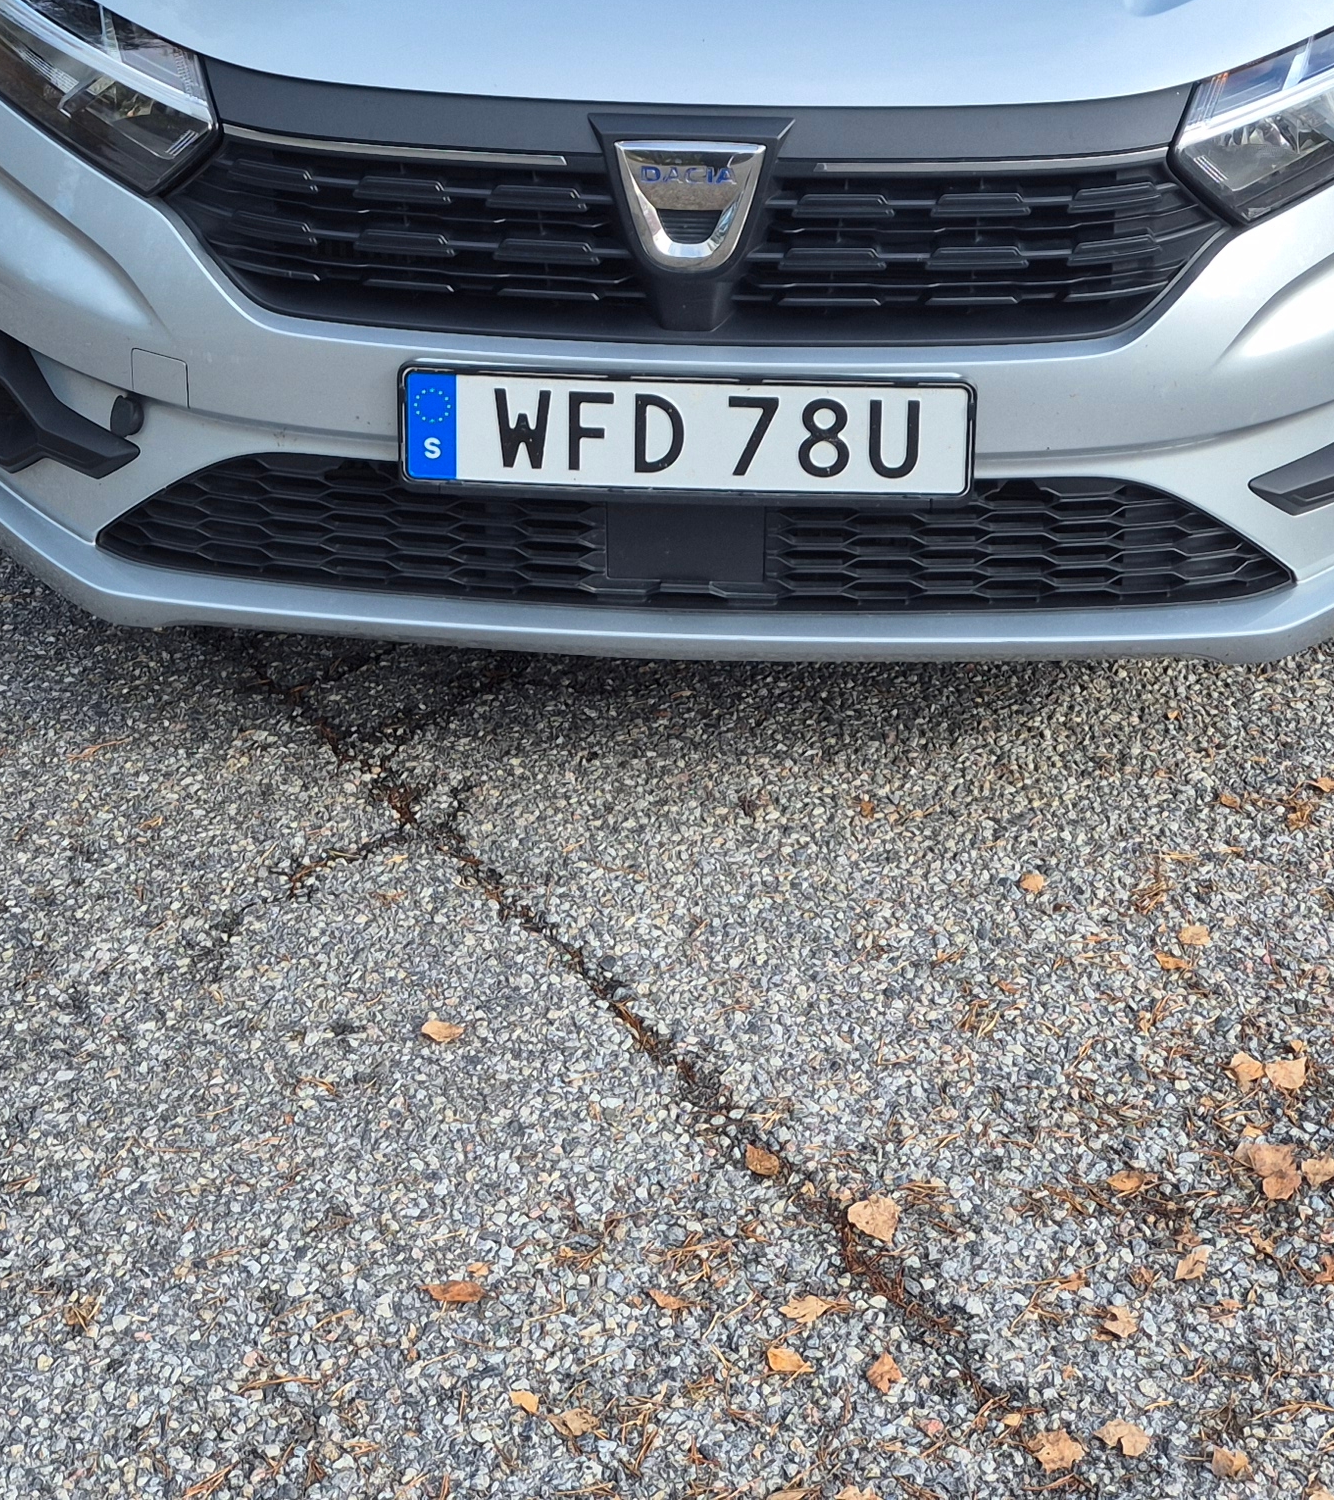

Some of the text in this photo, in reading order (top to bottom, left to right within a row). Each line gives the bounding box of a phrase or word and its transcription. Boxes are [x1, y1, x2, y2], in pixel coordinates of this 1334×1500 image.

[640, 165, 737, 186] DACIA
[493, 387, 921, 479] WFD 78U
[423, 436, 442, 460] S
